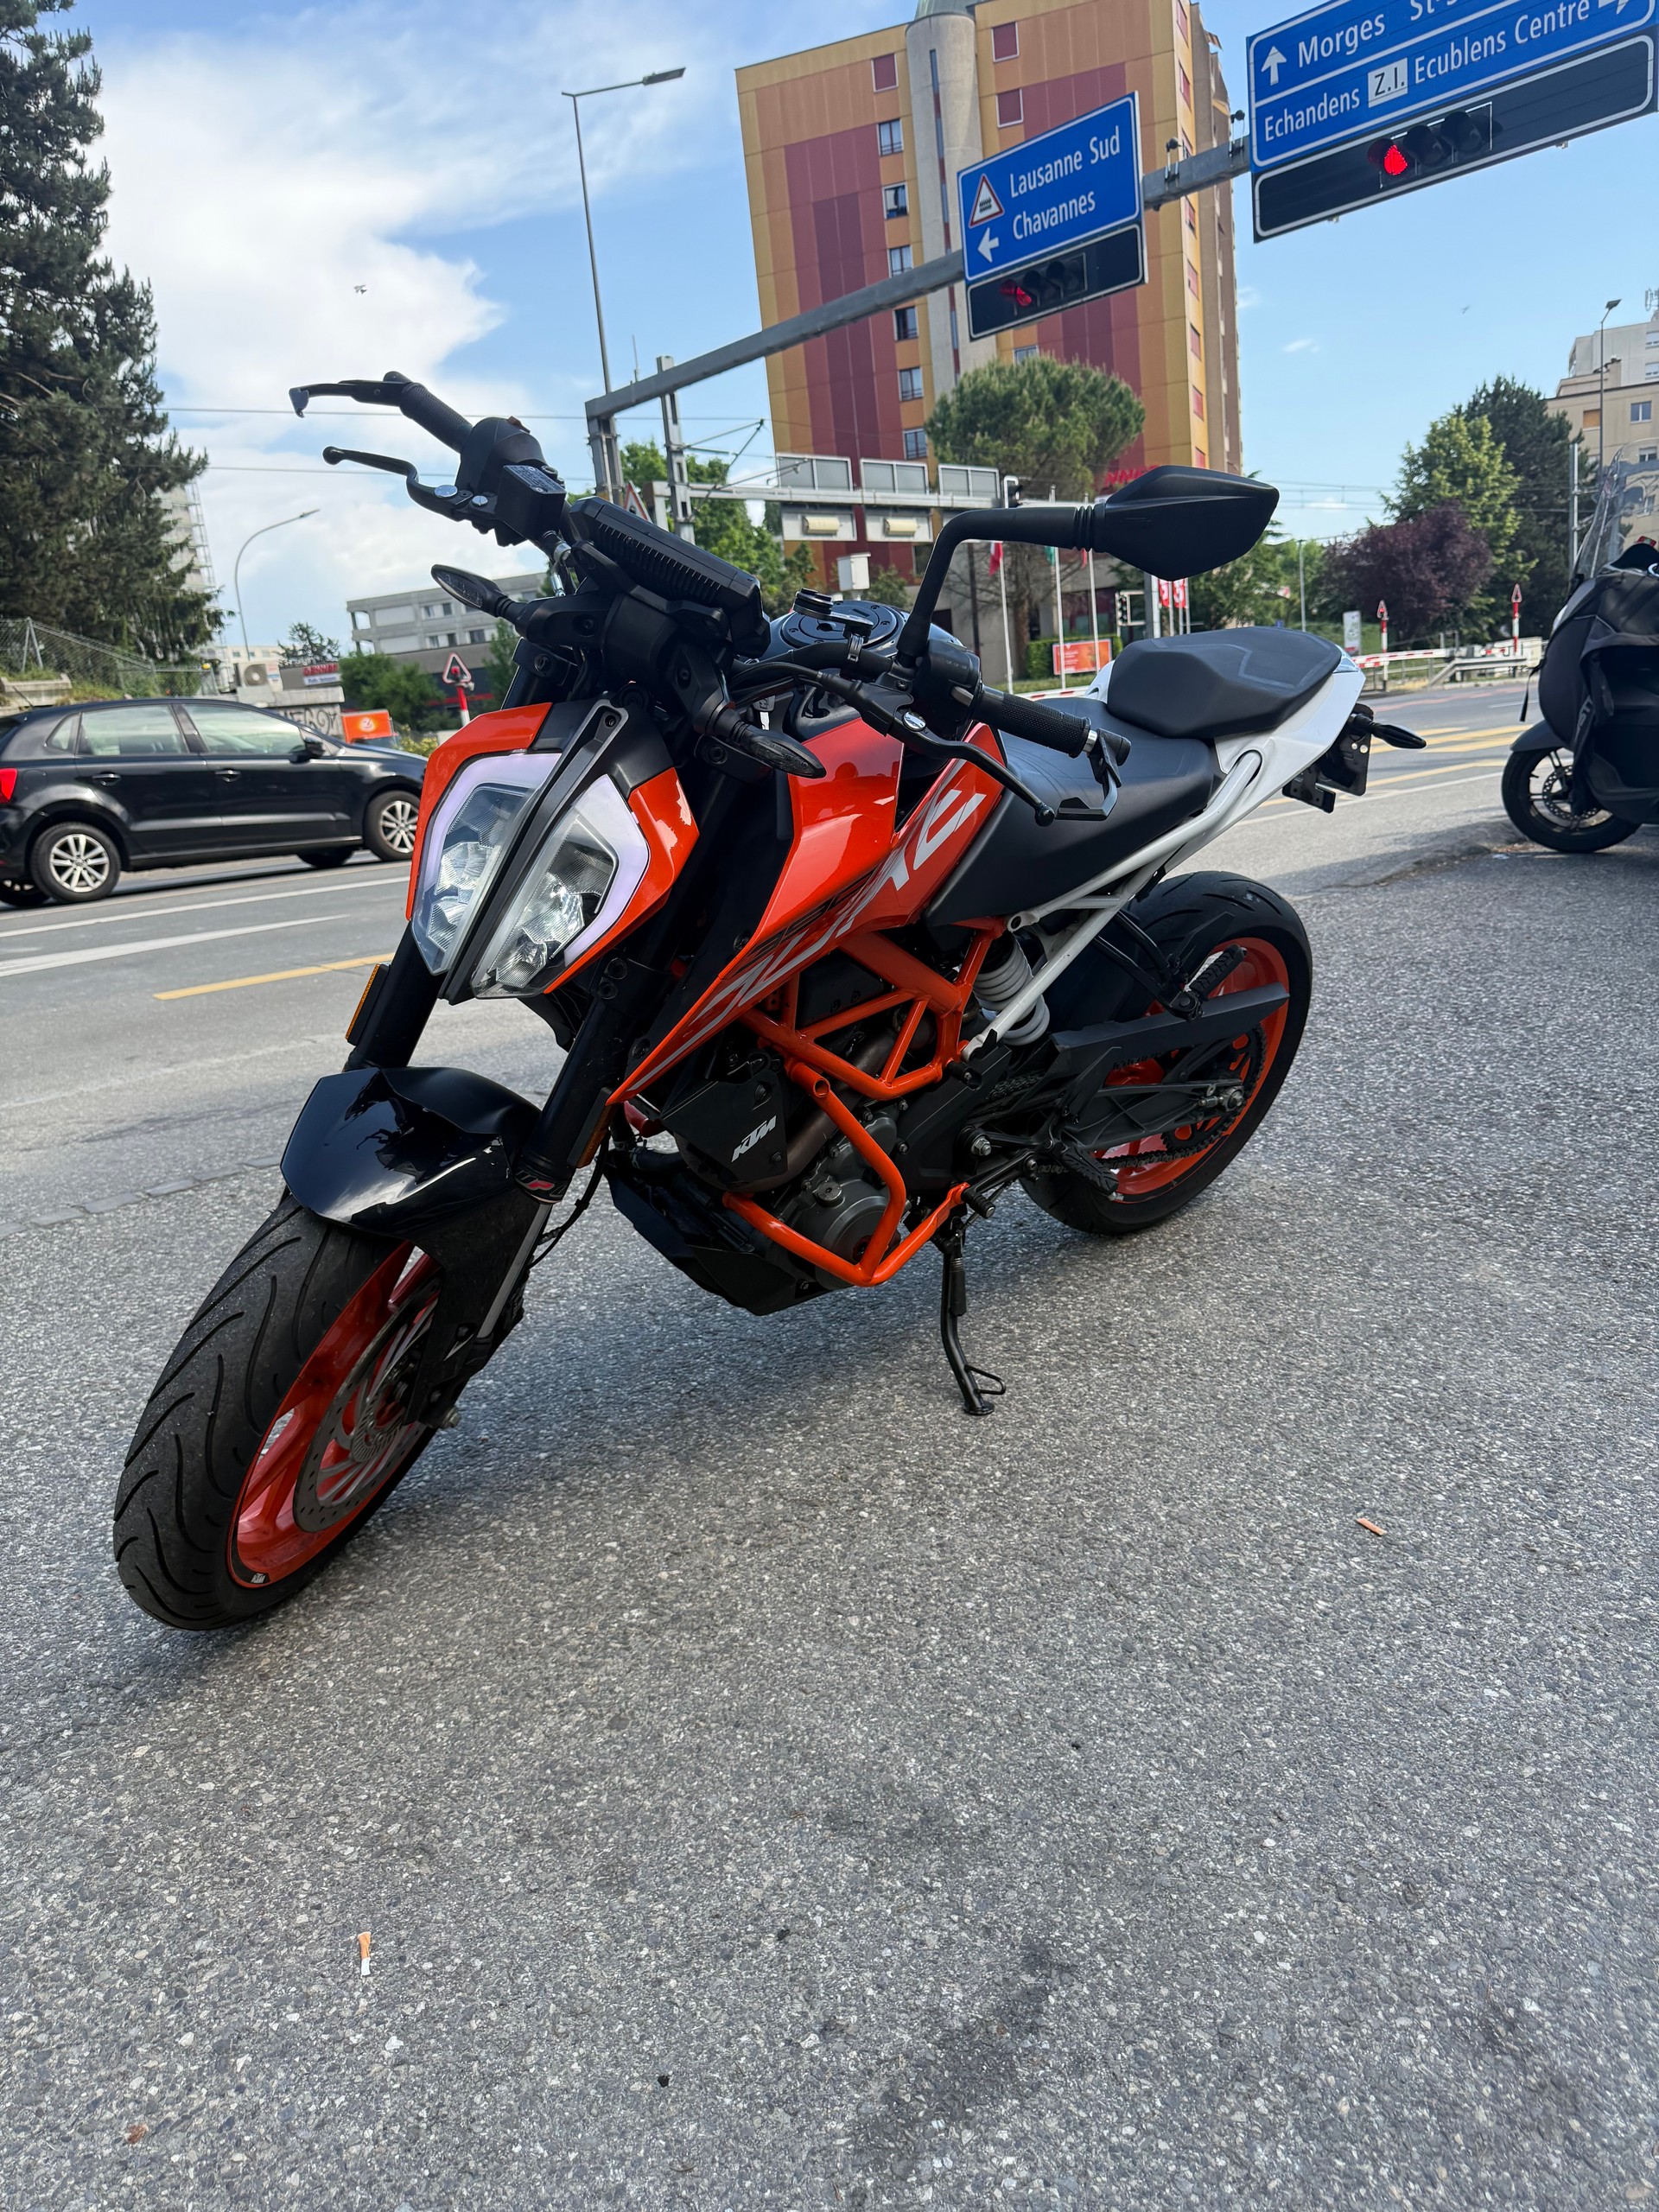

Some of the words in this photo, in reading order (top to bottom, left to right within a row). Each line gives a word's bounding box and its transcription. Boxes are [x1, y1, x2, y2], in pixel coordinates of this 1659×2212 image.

[1299, 14, 1386, 68] Morges
[1264, 88, 1361, 143] Echandens
[1374, 67, 1405, 97] Z.I.
[1415, 30, 1506, 85] Ecublens
[1514, 0, 1590, 44] Centre
[1009, 150, 1083, 199] Lausanne
[1089, 124, 1121, 164] Sud
[1012, 190, 1096, 240] Chavannes
[731, 1115, 777, 1163] KTM
